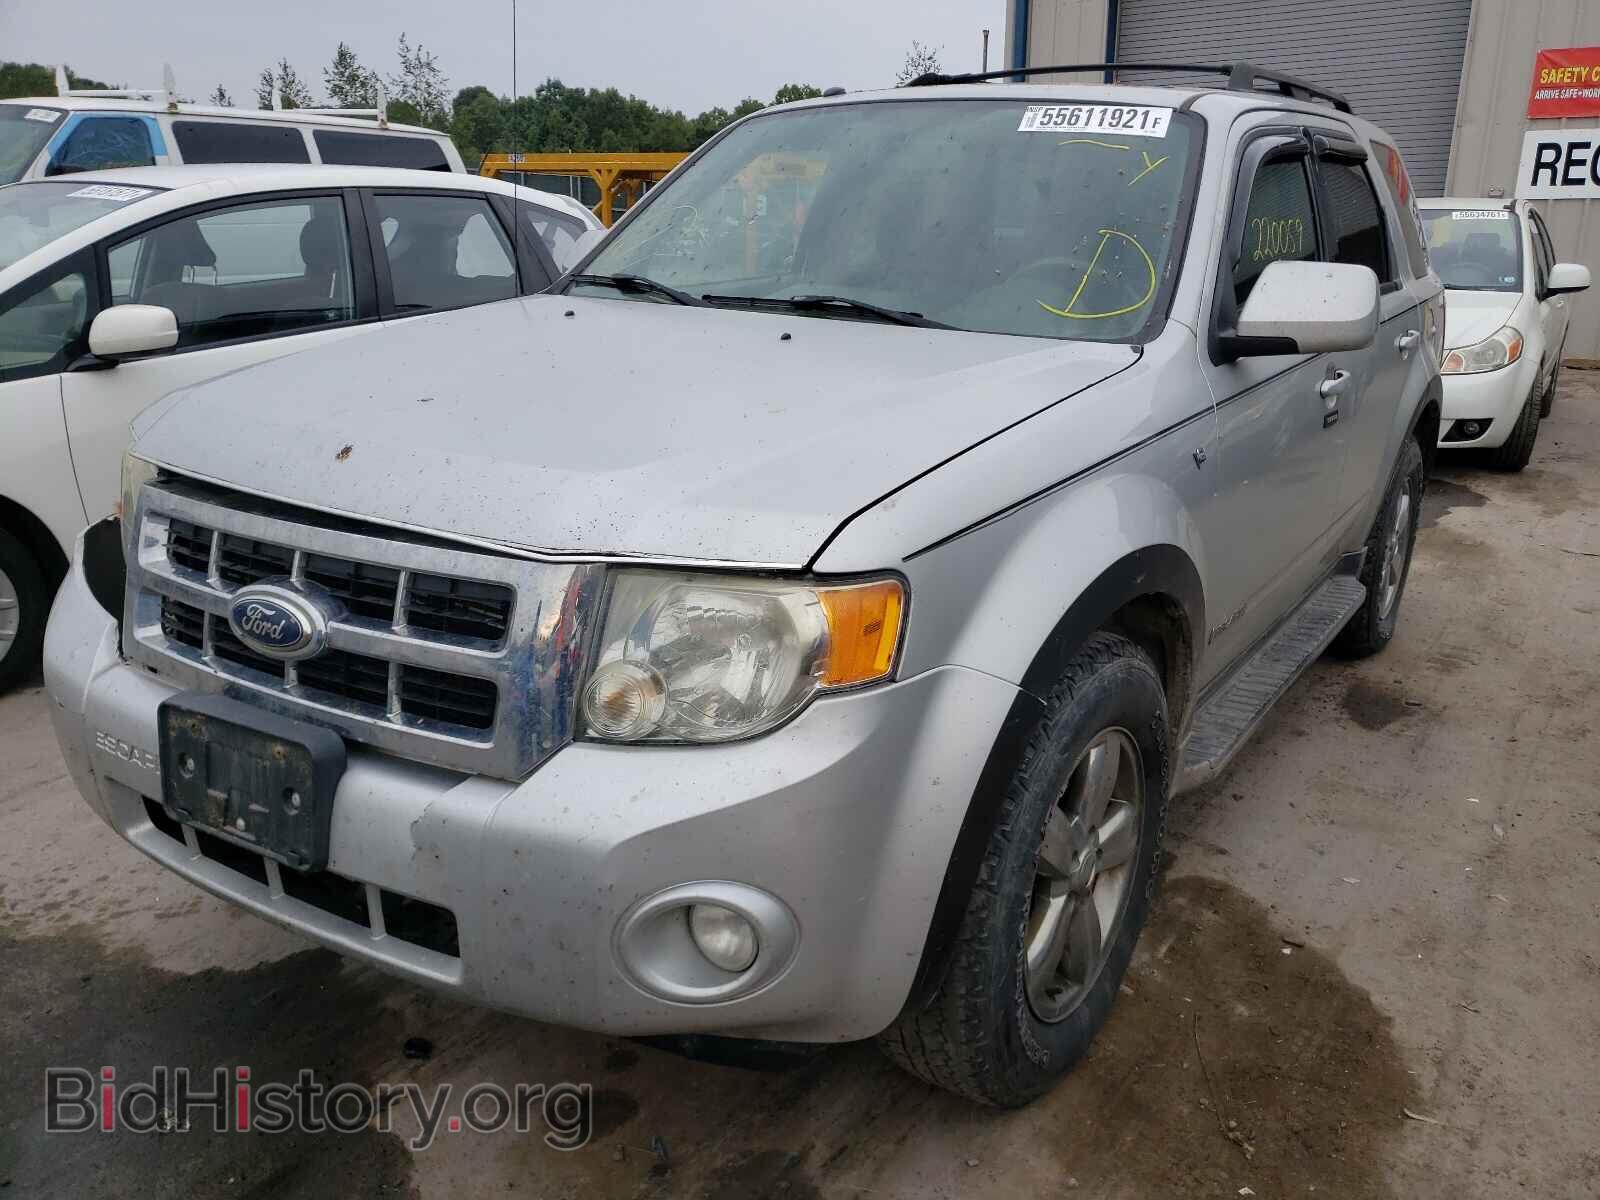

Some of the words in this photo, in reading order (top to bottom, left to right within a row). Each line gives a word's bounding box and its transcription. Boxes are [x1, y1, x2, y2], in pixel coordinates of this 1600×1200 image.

[1540, 66, 1590, 84] SAFETY
[1534, 89, 1560, 100] ARRIVE
[1040, 107, 1150, 130] 55611921
[241, 604, 287, 640] Ford
